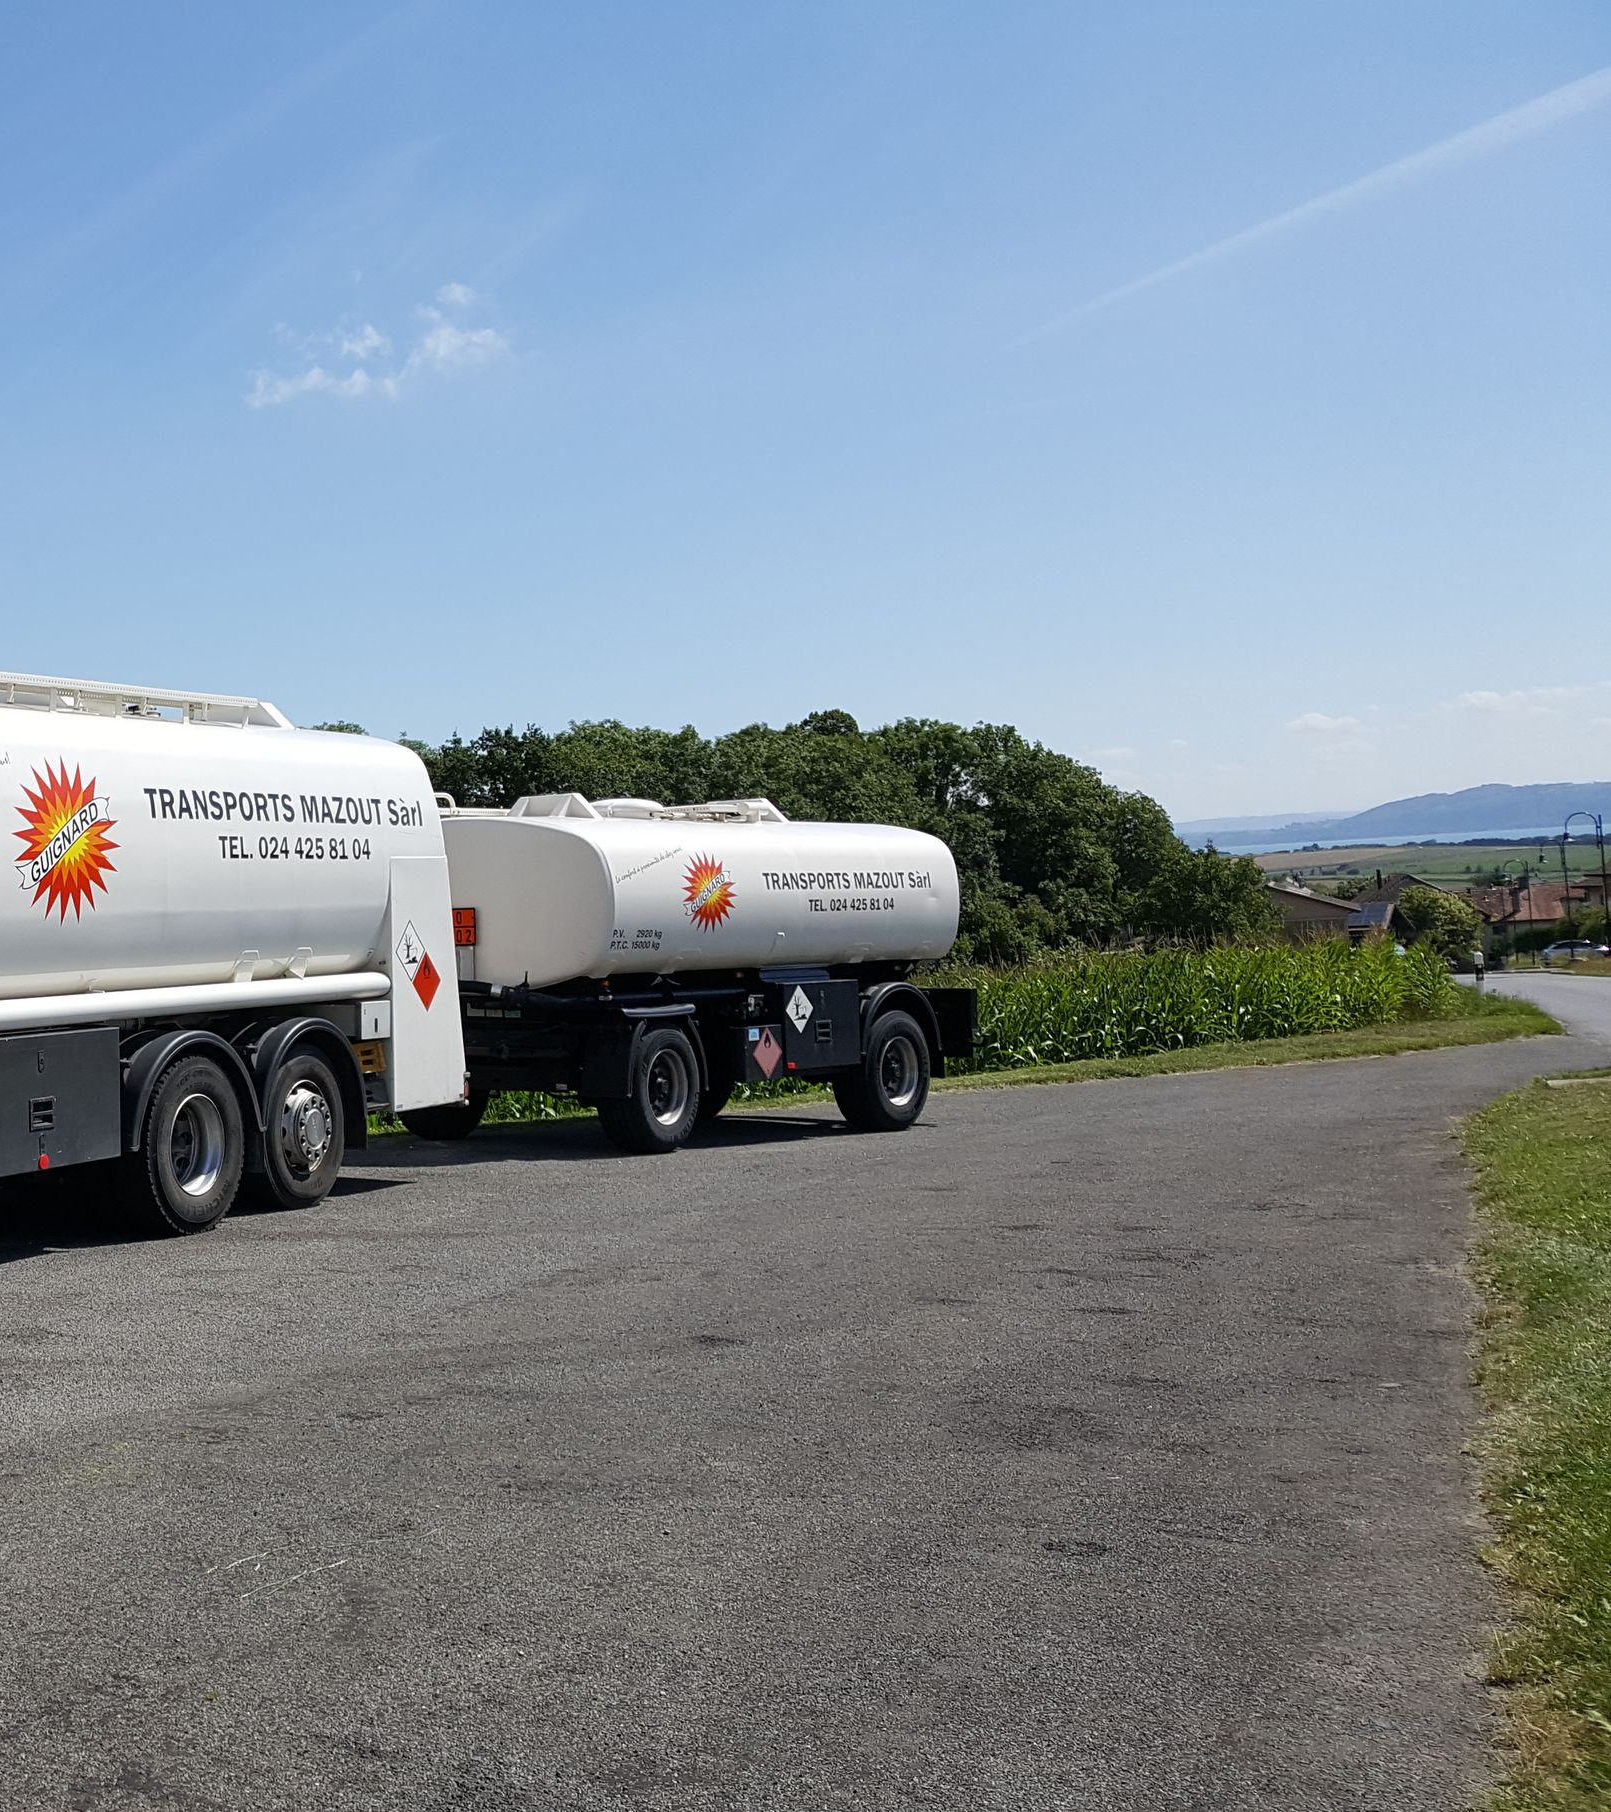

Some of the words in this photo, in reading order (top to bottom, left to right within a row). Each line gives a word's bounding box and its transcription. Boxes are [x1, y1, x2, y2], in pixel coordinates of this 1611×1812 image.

[143, 788, 296, 823] TRANSPORTS
[300, 794, 382, 825] MAZOUT
[386, 797, 424, 827] Sàrl
[31, 802, 98, 883] GUIGNARD
[218, 836, 254, 859] TEL.
[258, 836, 290, 859] 024
[294, 837, 324, 860] 425
[329, 838, 348, 860] 81
[352, 838, 371, 860] 04
[762, 872, 851, 890] TRANSPORTS
[853, 872, 905, 889] MAZOUT
[907, 871, 932, 889] Sàrl
[690, 872, 726, 914] GUIGNARD
[808, 899, 828, 912] TEL.
[830, 899, 848, 911] 024
[850, 898, 868, 911] 425
[869, 898, 880, 911] 81
[883, 897, 895, 910] 04
[612, 929, 626, 938] P.V.
[636, 929, 654, 938] 2920
[654, 929, 663, 940] kg
[610, 941, 629, 950] P.T.C.
[631, 941, 651, 950] 15000
[651, 941, 660, 951] kg
